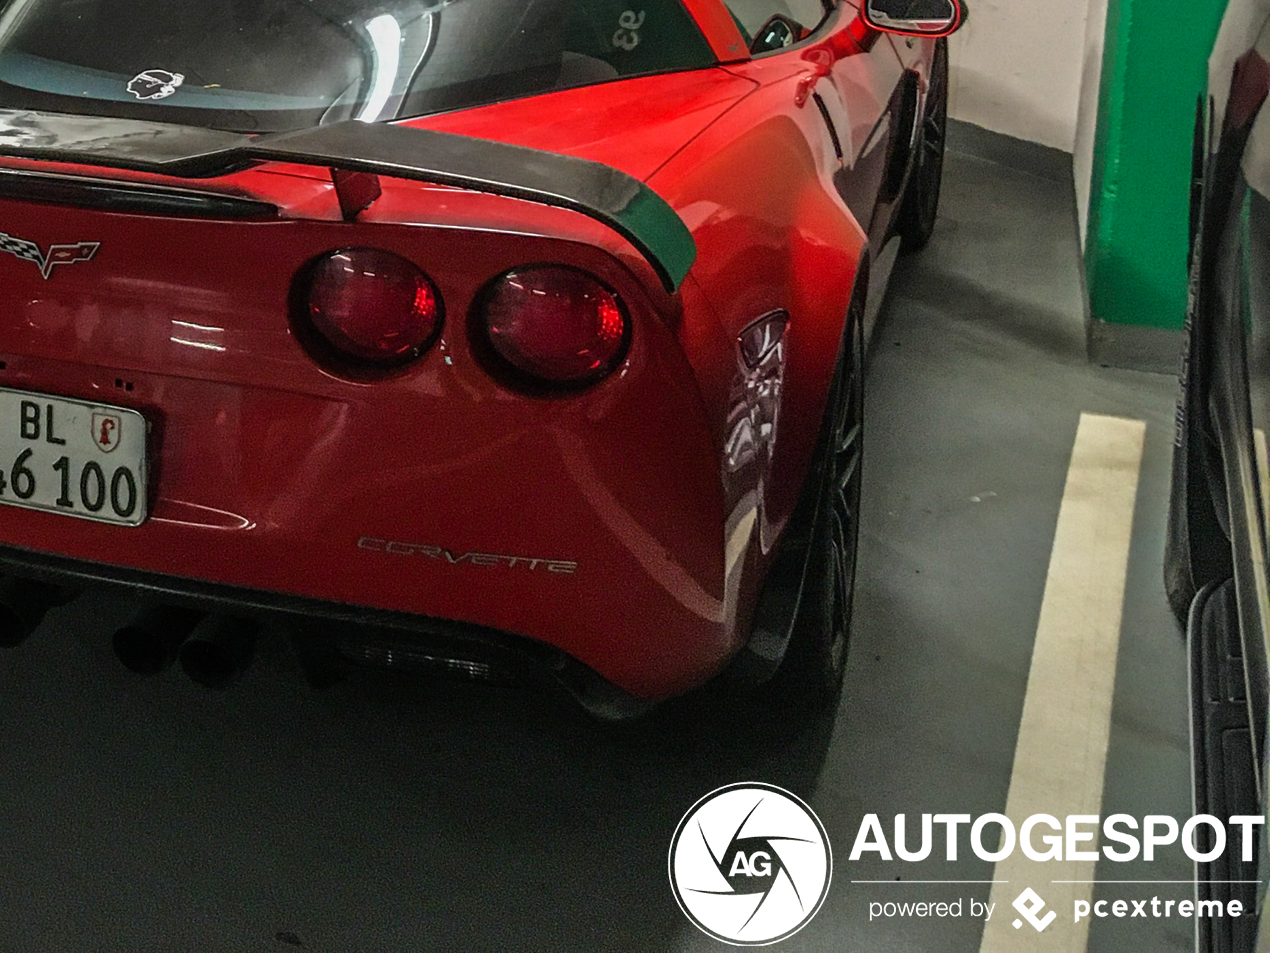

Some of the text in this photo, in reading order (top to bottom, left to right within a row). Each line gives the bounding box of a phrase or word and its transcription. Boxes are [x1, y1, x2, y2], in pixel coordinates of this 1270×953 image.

[19, 400, 67, 446] BL
[52, 455, 137, 518] 100
[357, 536, 579, 574] CORVETTE
